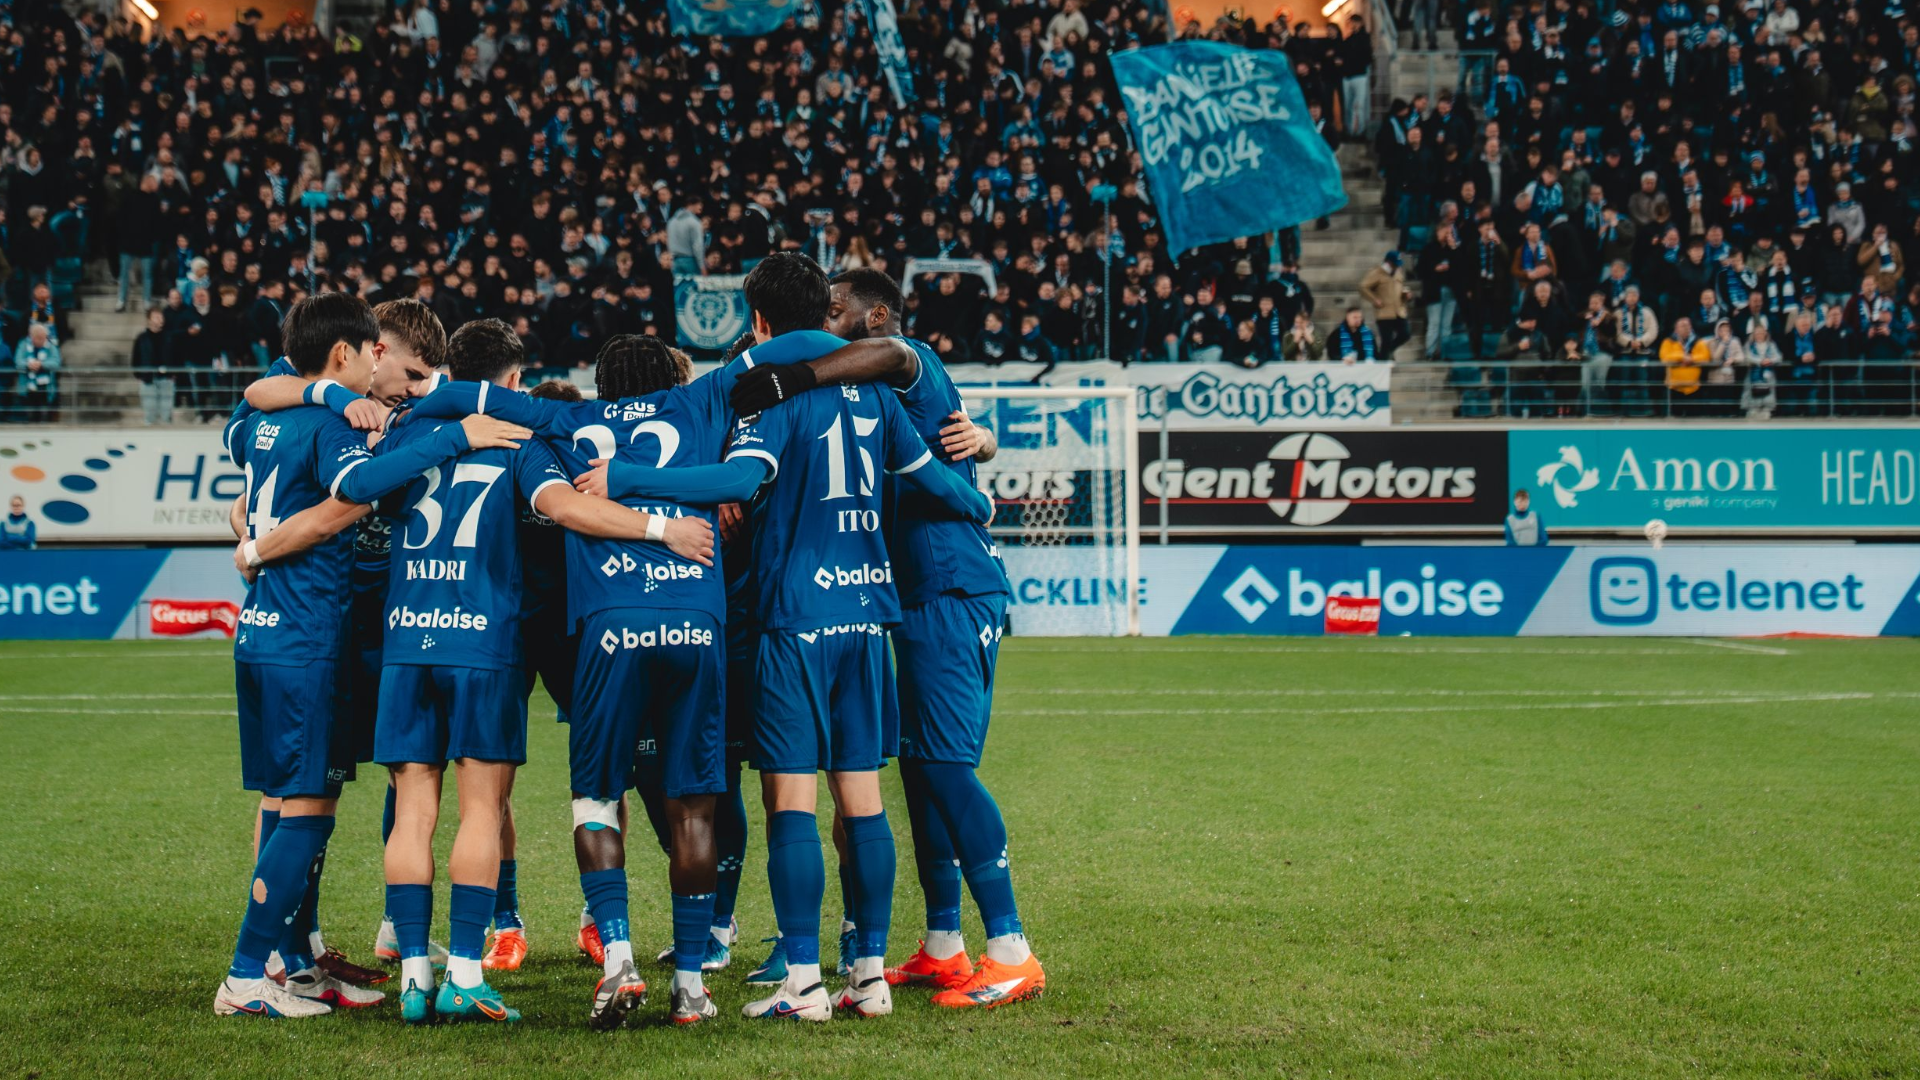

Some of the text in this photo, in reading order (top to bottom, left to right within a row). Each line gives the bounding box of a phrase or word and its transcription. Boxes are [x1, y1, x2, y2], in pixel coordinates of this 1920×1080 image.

[1181, 130, 1264, 193] 2014
[1181, 371, 1378, 425] Gantoise
[817, 412, 879, 500] 15
[1142, 459, 1476, 499] Gent Motors
[1607, 448, 1915, 506] Amon HEAD
[403, 463, 506, 549] 37
[838, 510, 879, 532] ITO
[406, 559, 466, 581] KADRI
[622, 553, 703, 580] bloise
[835, 561, 893, 586] baloi
[1666, 569, 1865, 612] telenet
[400, 606, 488, 631] baloise
[622, 621, 712, 649] baloise
